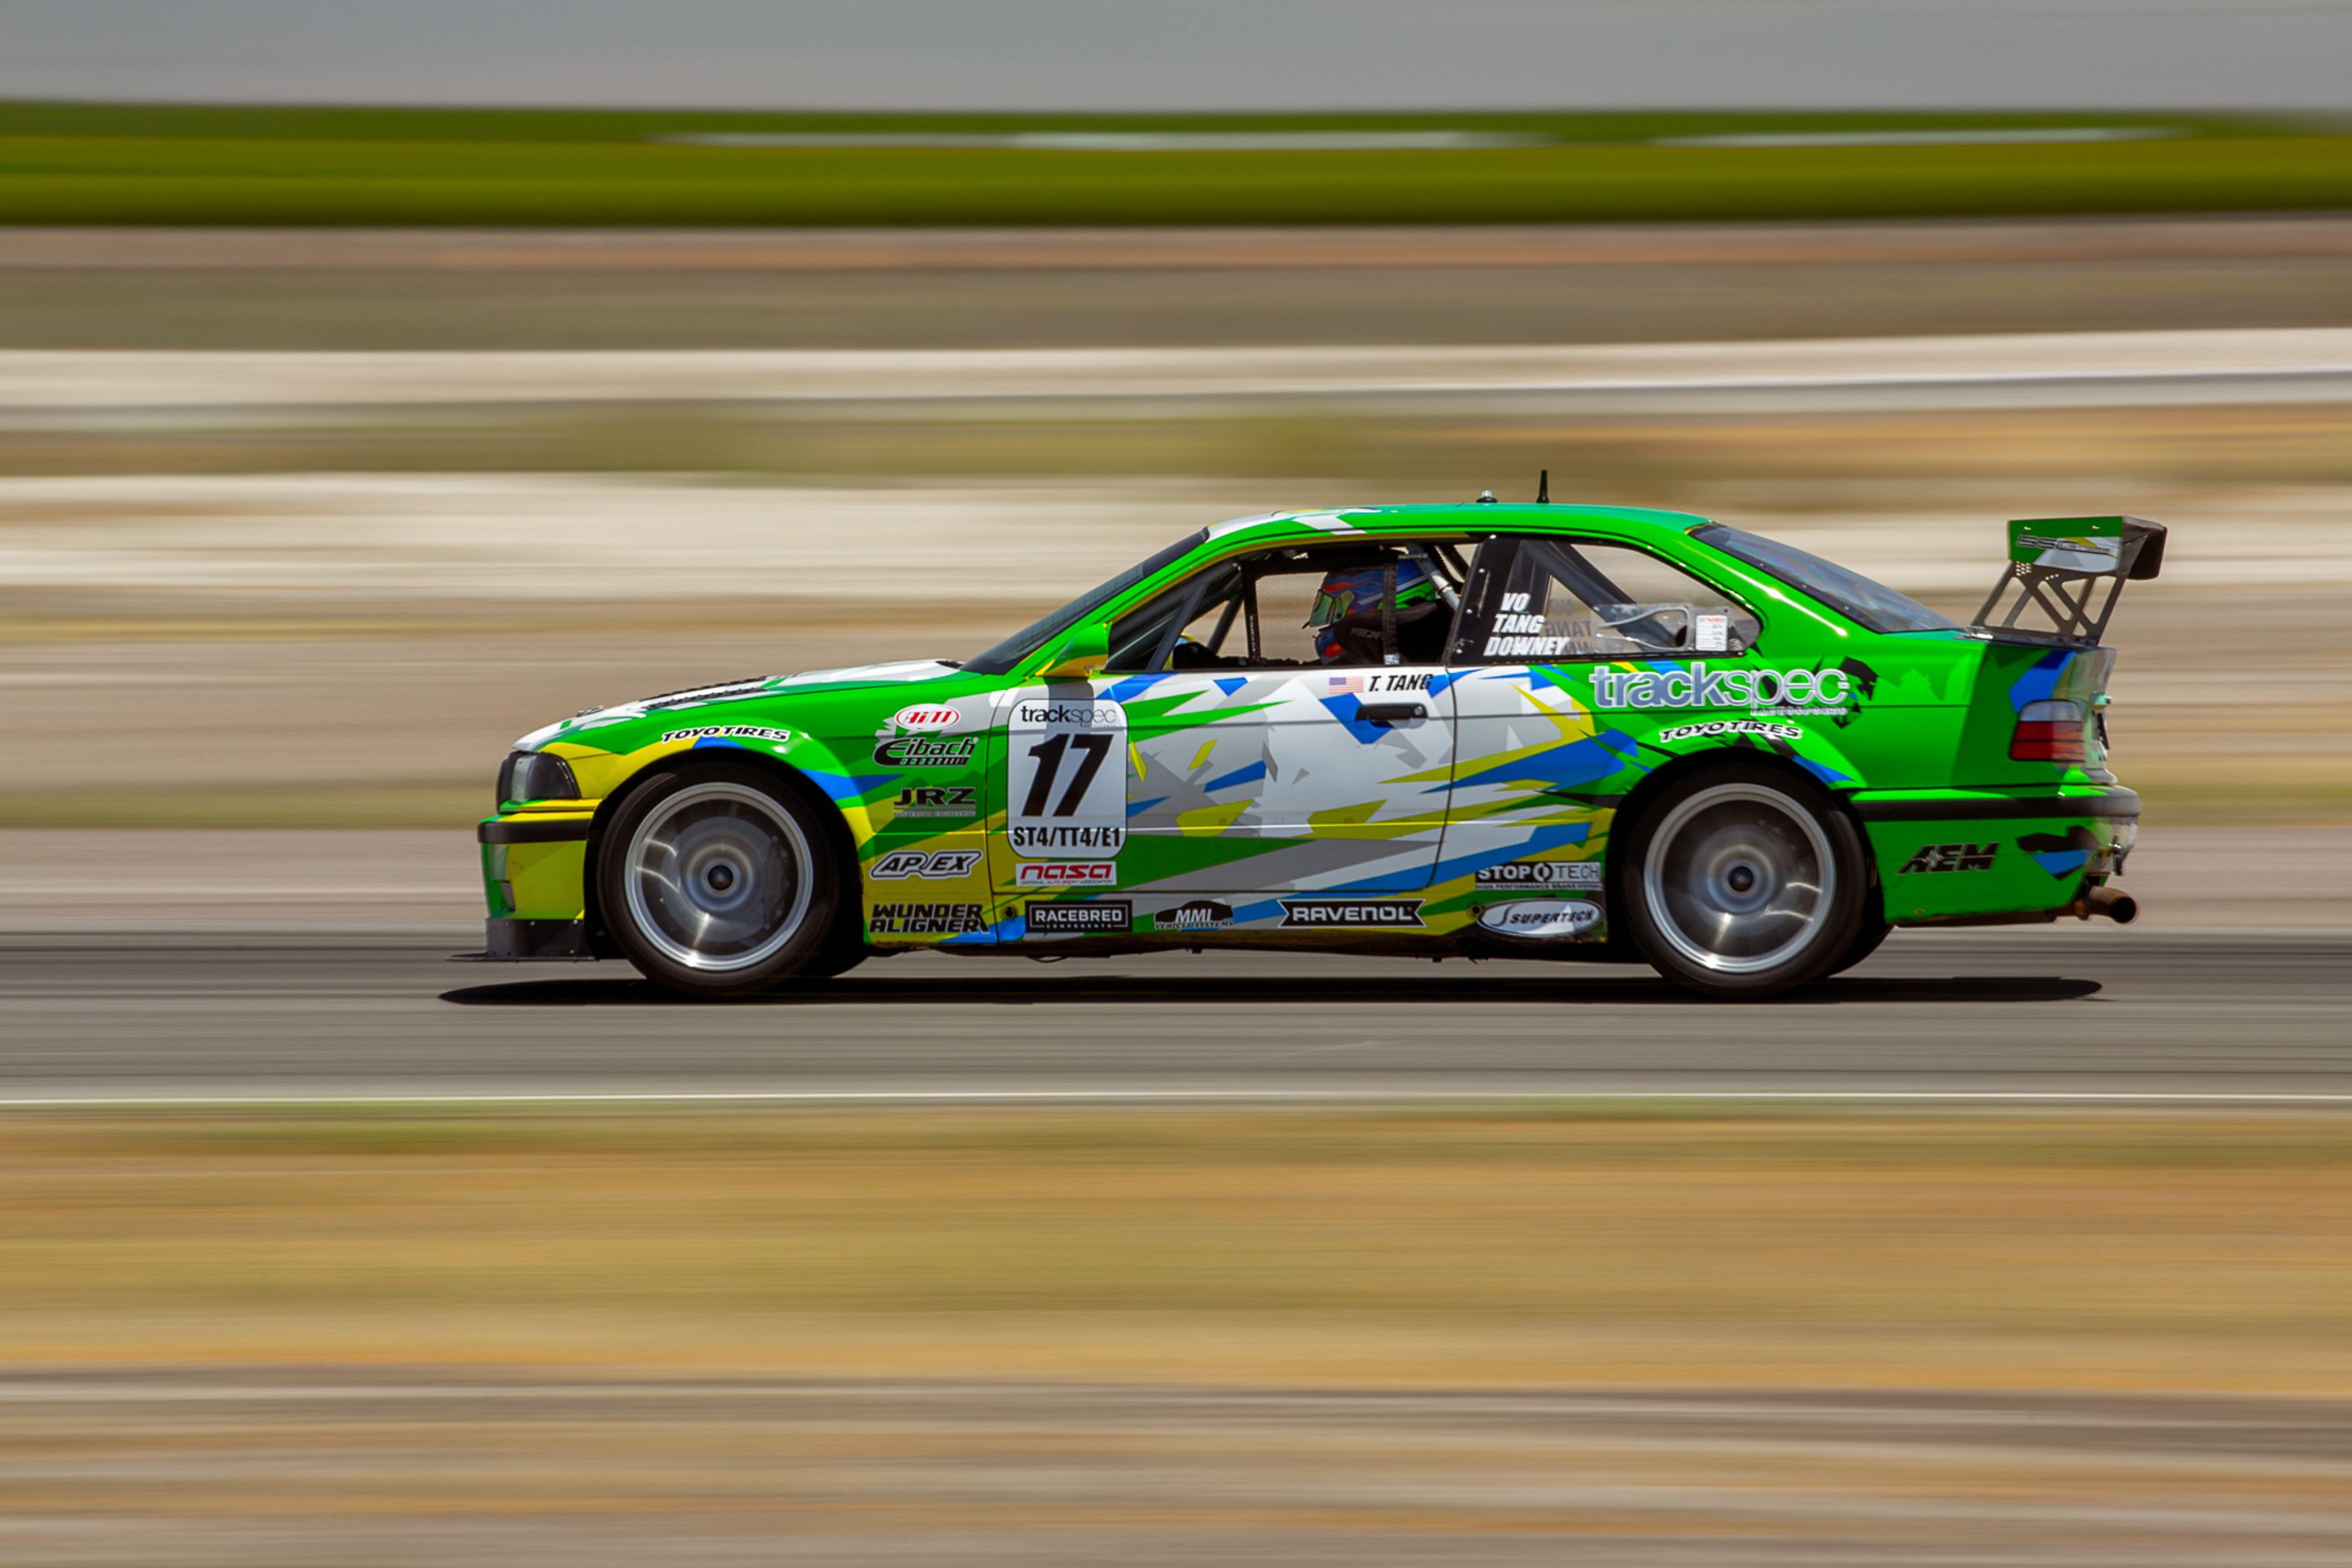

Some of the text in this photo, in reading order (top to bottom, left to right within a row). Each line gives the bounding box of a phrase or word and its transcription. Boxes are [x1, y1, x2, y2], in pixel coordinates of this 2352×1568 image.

[1501, 593, 1530, 612] VO
[1492, 614, 1546, 633] TANG
[1483, 637, 1570, 657] DOWNEY
[1369, 674, 1433, 692] T. TANG
[1590, 662, 1848, 715] trackspec
[1021, 705, 1117, 727] trackspec
[662, 726, 789, 742] TOYO TIRES
[1661, 722, 1799, 742] TOYO TIRES
[874, 737, 976, 766] Eibach
[1022, 733, 1115, 817] 17
[893, 787, 975, 805] JRZ
[1013, 826, 1120, 847] ST4/TT4/E1
[879, 856, 972, 872] APEX
[1895, 841, 2000, 875] AEM
[1020, 865, 1112, 880] nasa
[1477, 864, 1601, 880] STOP TECH
[872, 903, 985, 918] WUNDER
[1036, 910, 1123, 922] RACEBRED
[1174, 908, 1213, 923] MMI
[1292, 906, 1413, 922] RAVENOL
[1511, 910, 1594, 924] SUPERTECH
[869, 918, 987, 933] ALIGNER
